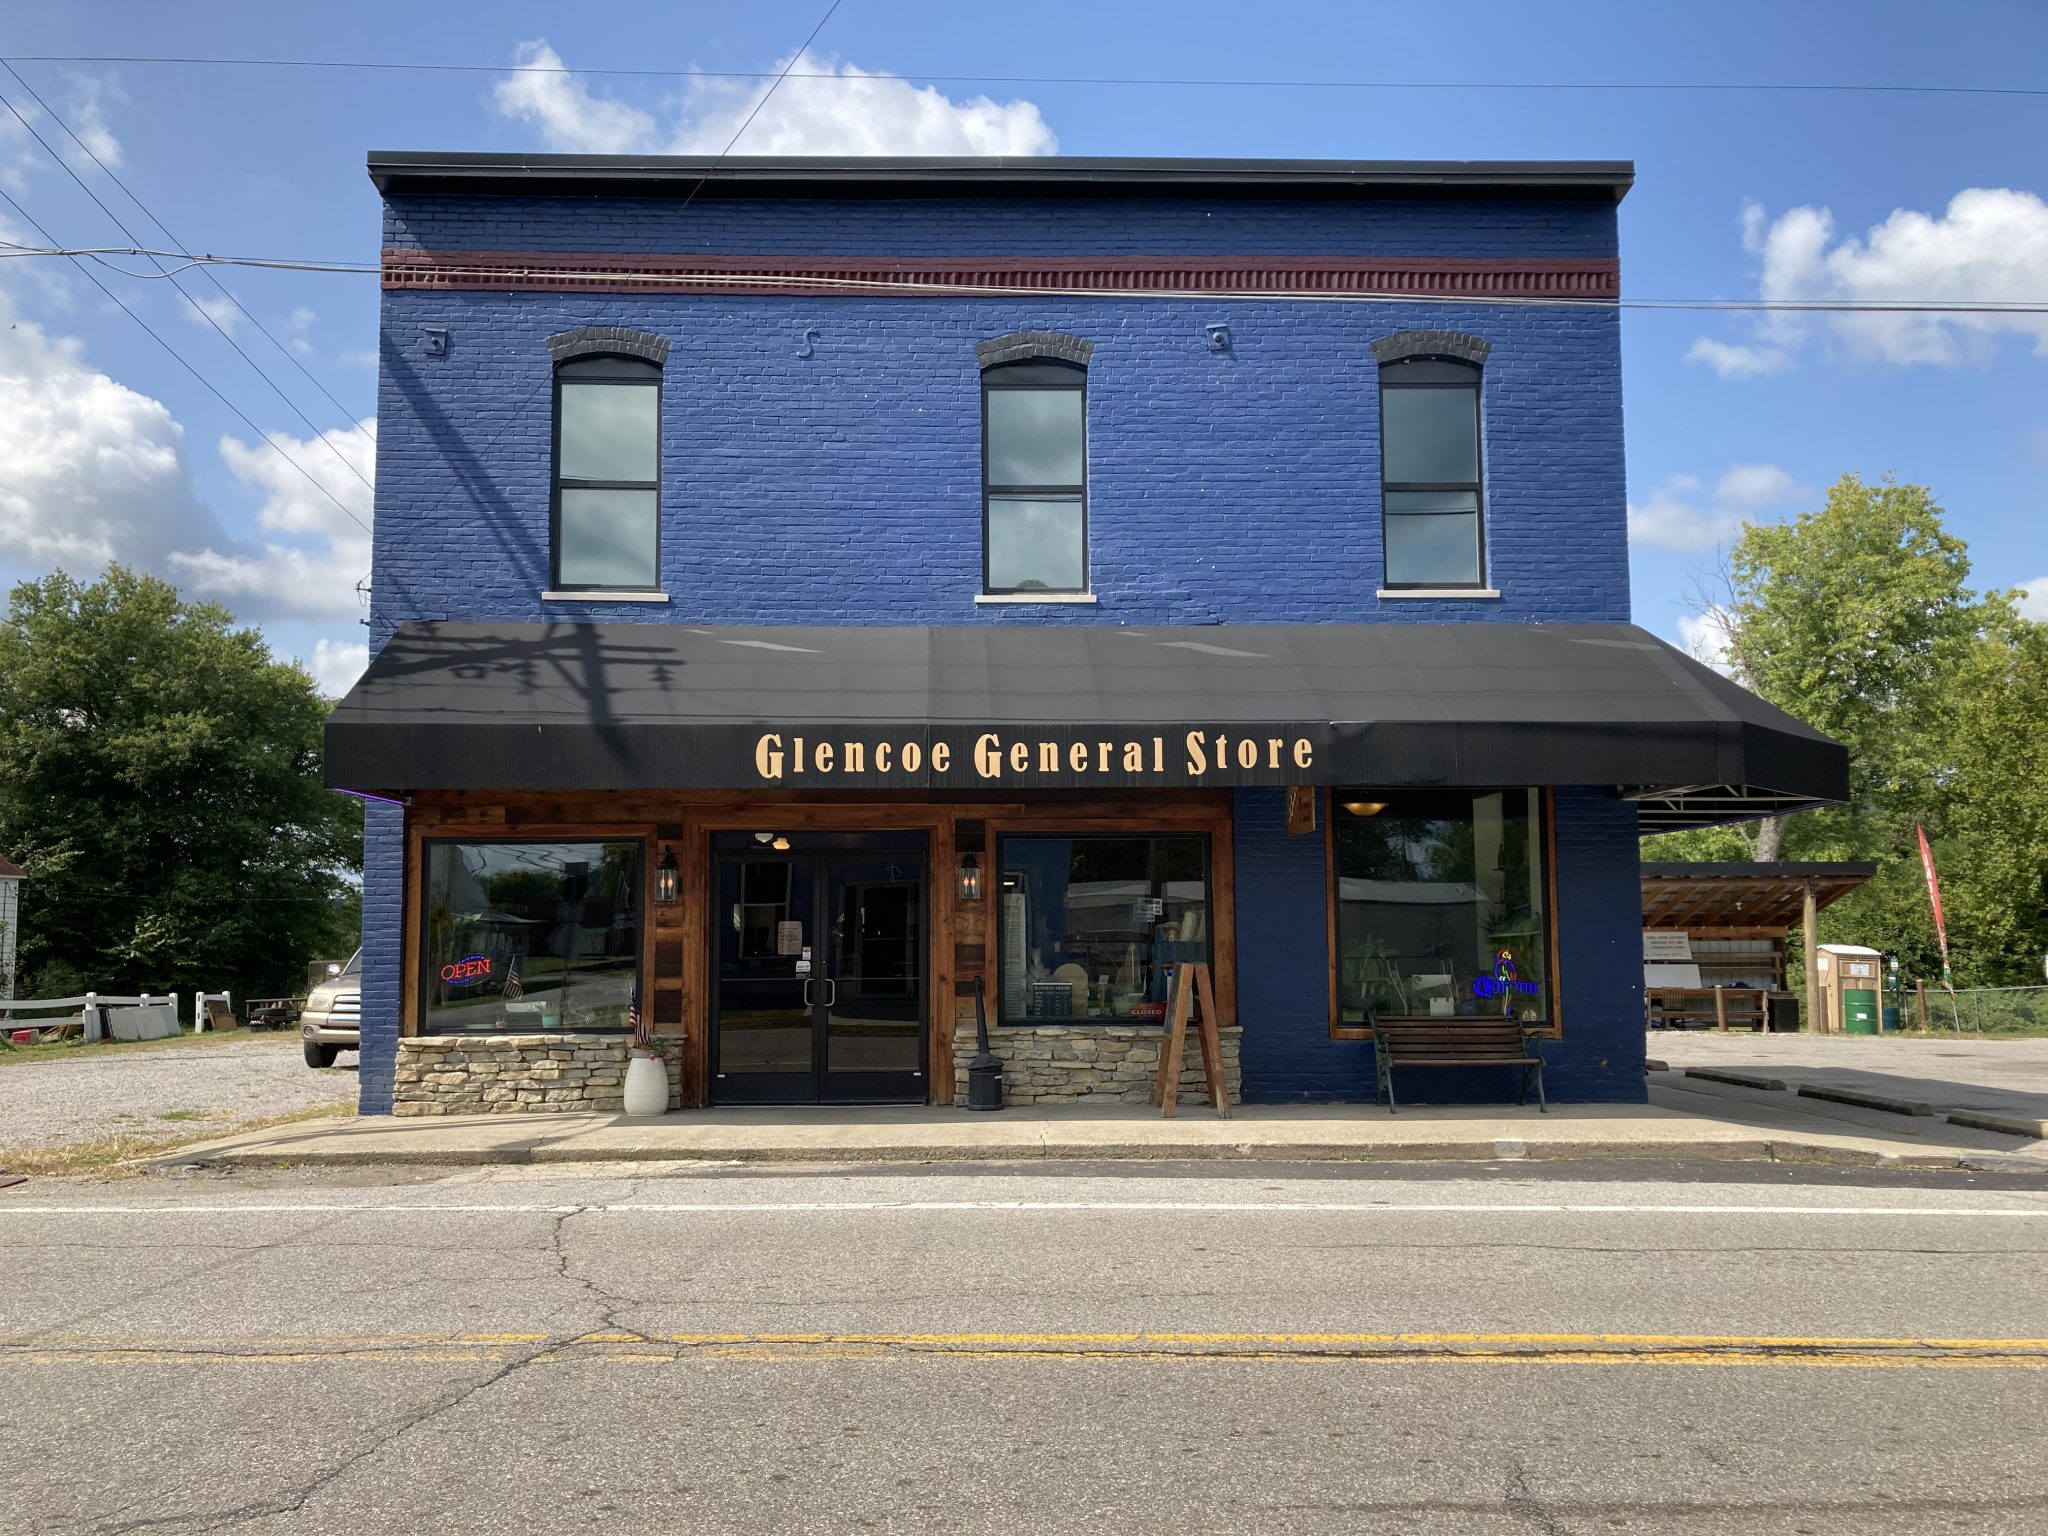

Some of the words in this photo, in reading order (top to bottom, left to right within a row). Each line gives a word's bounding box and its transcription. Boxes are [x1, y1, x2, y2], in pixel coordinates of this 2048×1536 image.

[755, 734, 950, 779] Glencoe
[973, 733, 1164, 778] General
[1186, 731, 1313, 776] Store
[440, 959, 491, 980] OPEN
[1130, 1008, 1162, 1016] CLOSED
